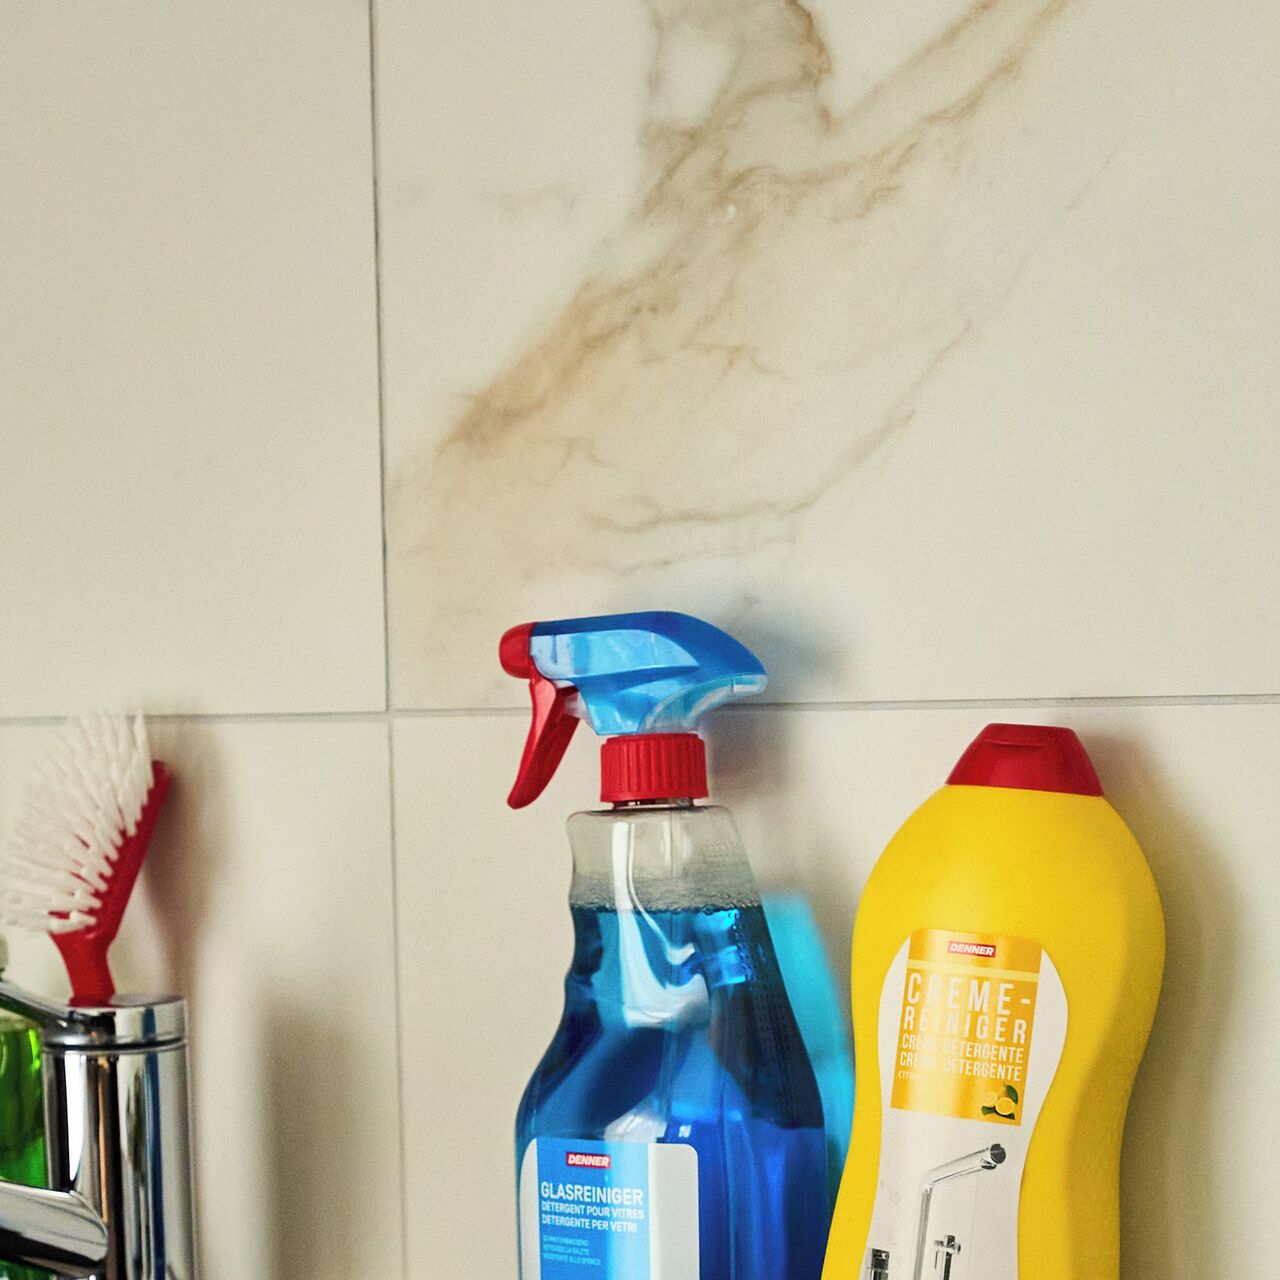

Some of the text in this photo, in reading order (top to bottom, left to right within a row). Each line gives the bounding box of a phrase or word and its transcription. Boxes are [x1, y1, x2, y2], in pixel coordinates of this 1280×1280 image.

[949, 943, 994, 956] DENNER
[903, 1006, 1027, 1045] REINIGER
[942, 1038, 1024, 1064] DETERGENTE
[941, 1055, 1022, 1082] DETERGENTE
[568, 1154, 610, 1167] DENNER
[541, 1181, 644, 1206] GLASREINIGER
[541, 1213, 638, 1233] DETERGENTE PER VETRI
[586, 1206, 610, 1217] POUR
[611, 1207, 645, 1219] VITRES
